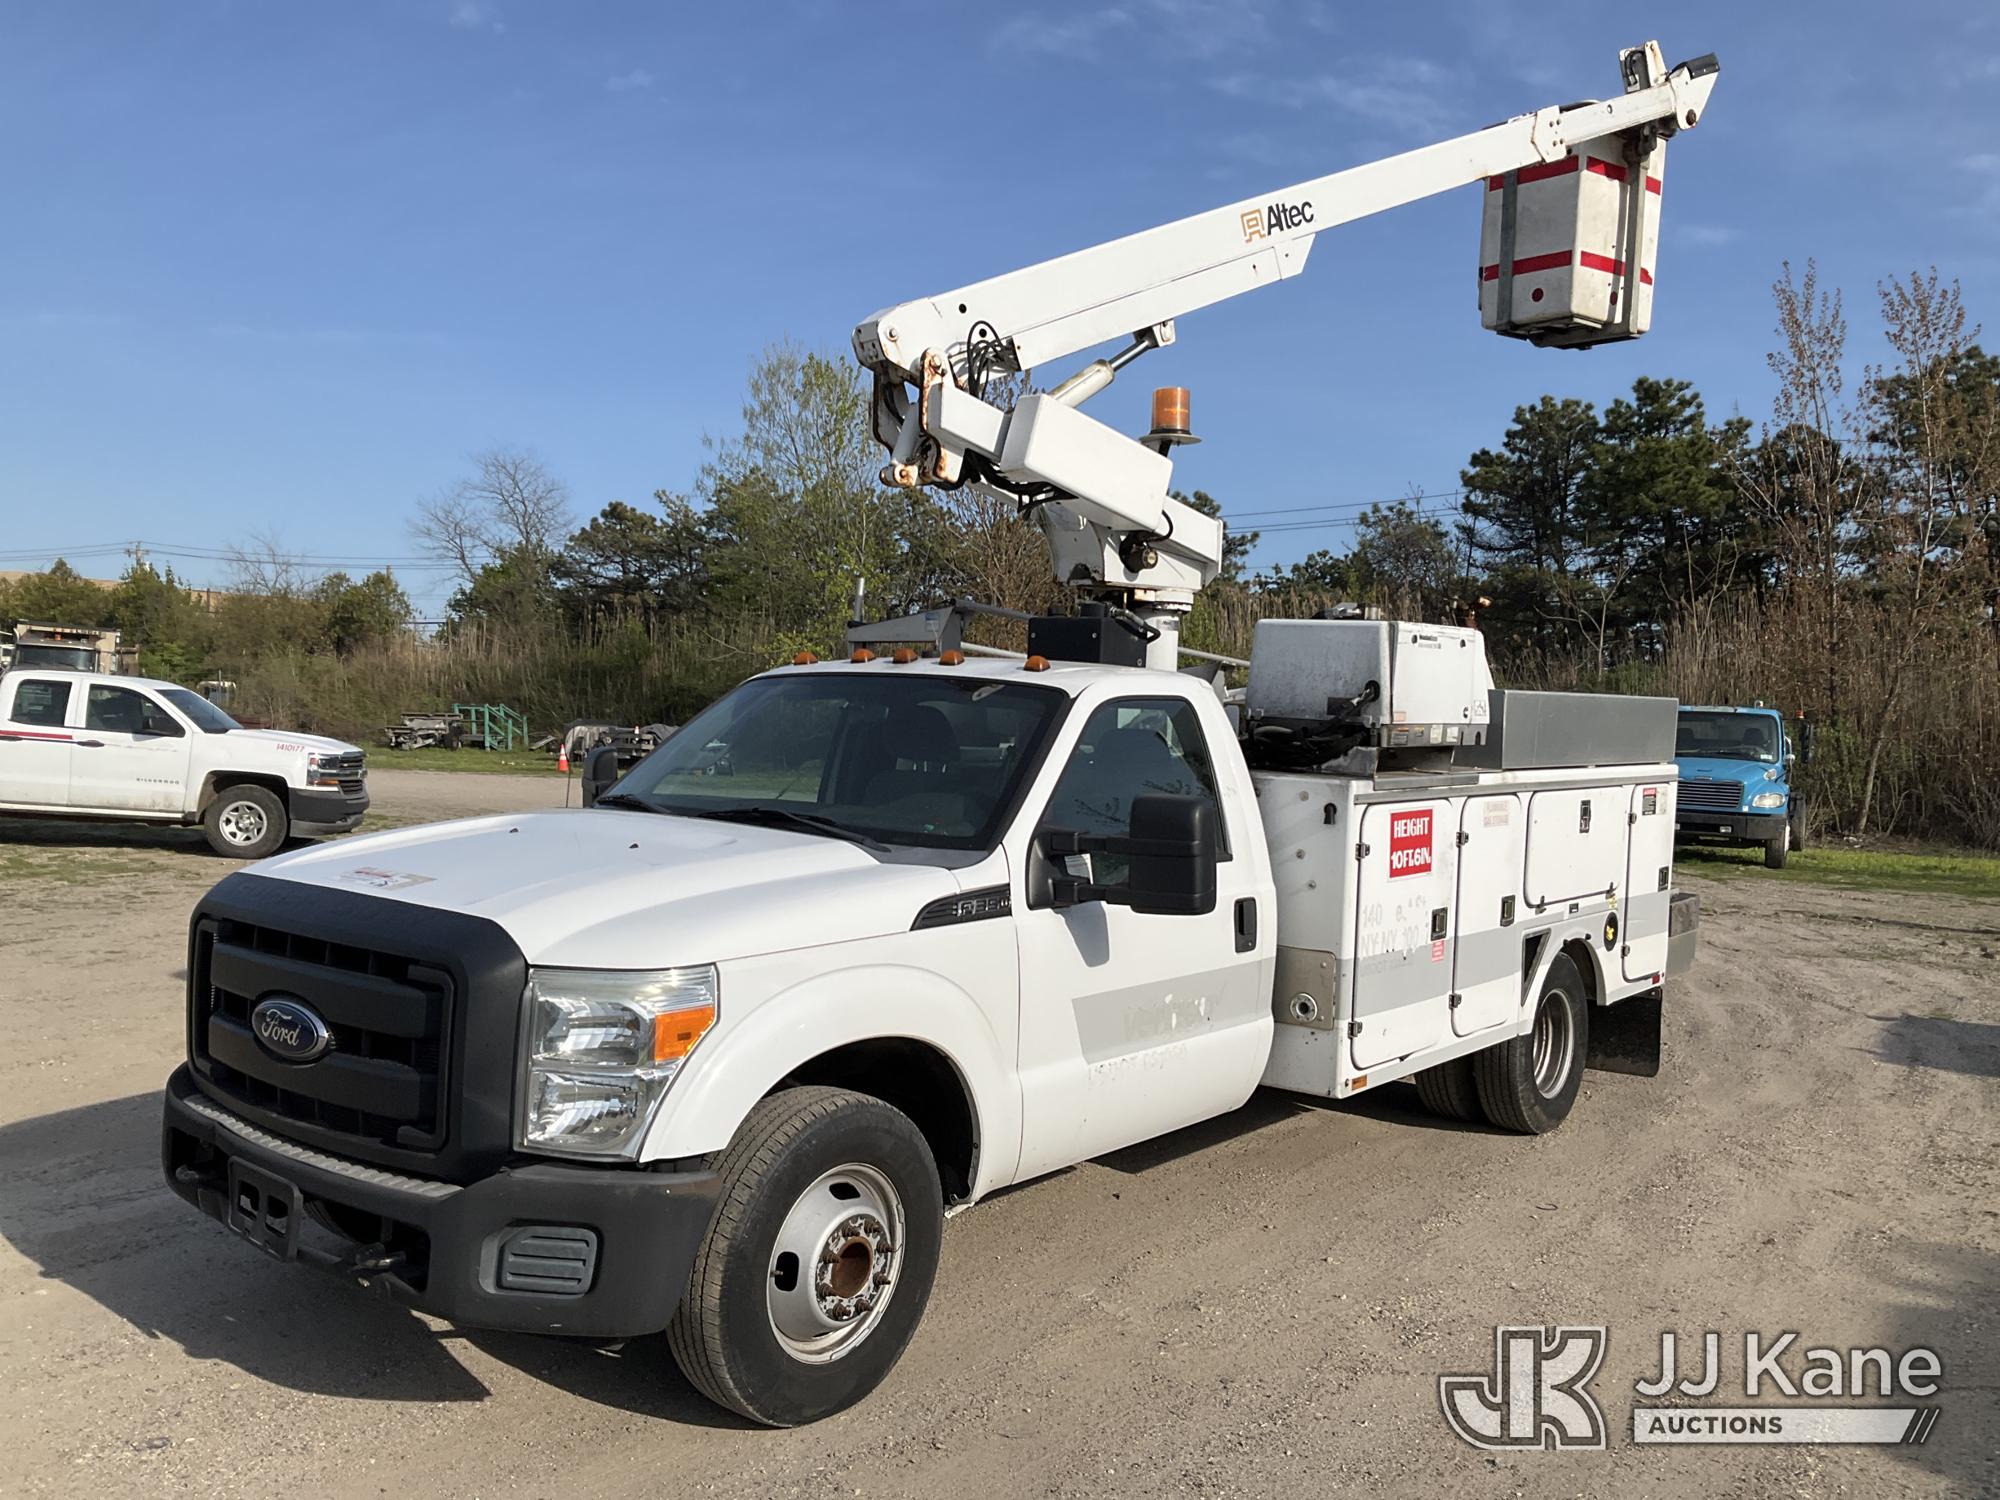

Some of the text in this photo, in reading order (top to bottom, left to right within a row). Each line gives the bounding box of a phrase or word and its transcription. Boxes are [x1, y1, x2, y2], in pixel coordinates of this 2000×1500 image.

[1267, 201, 1314, 236] Altec
[1393, 816, 1430, 839] HEIGHT
[261, 1008, 302, 1047] Ford
